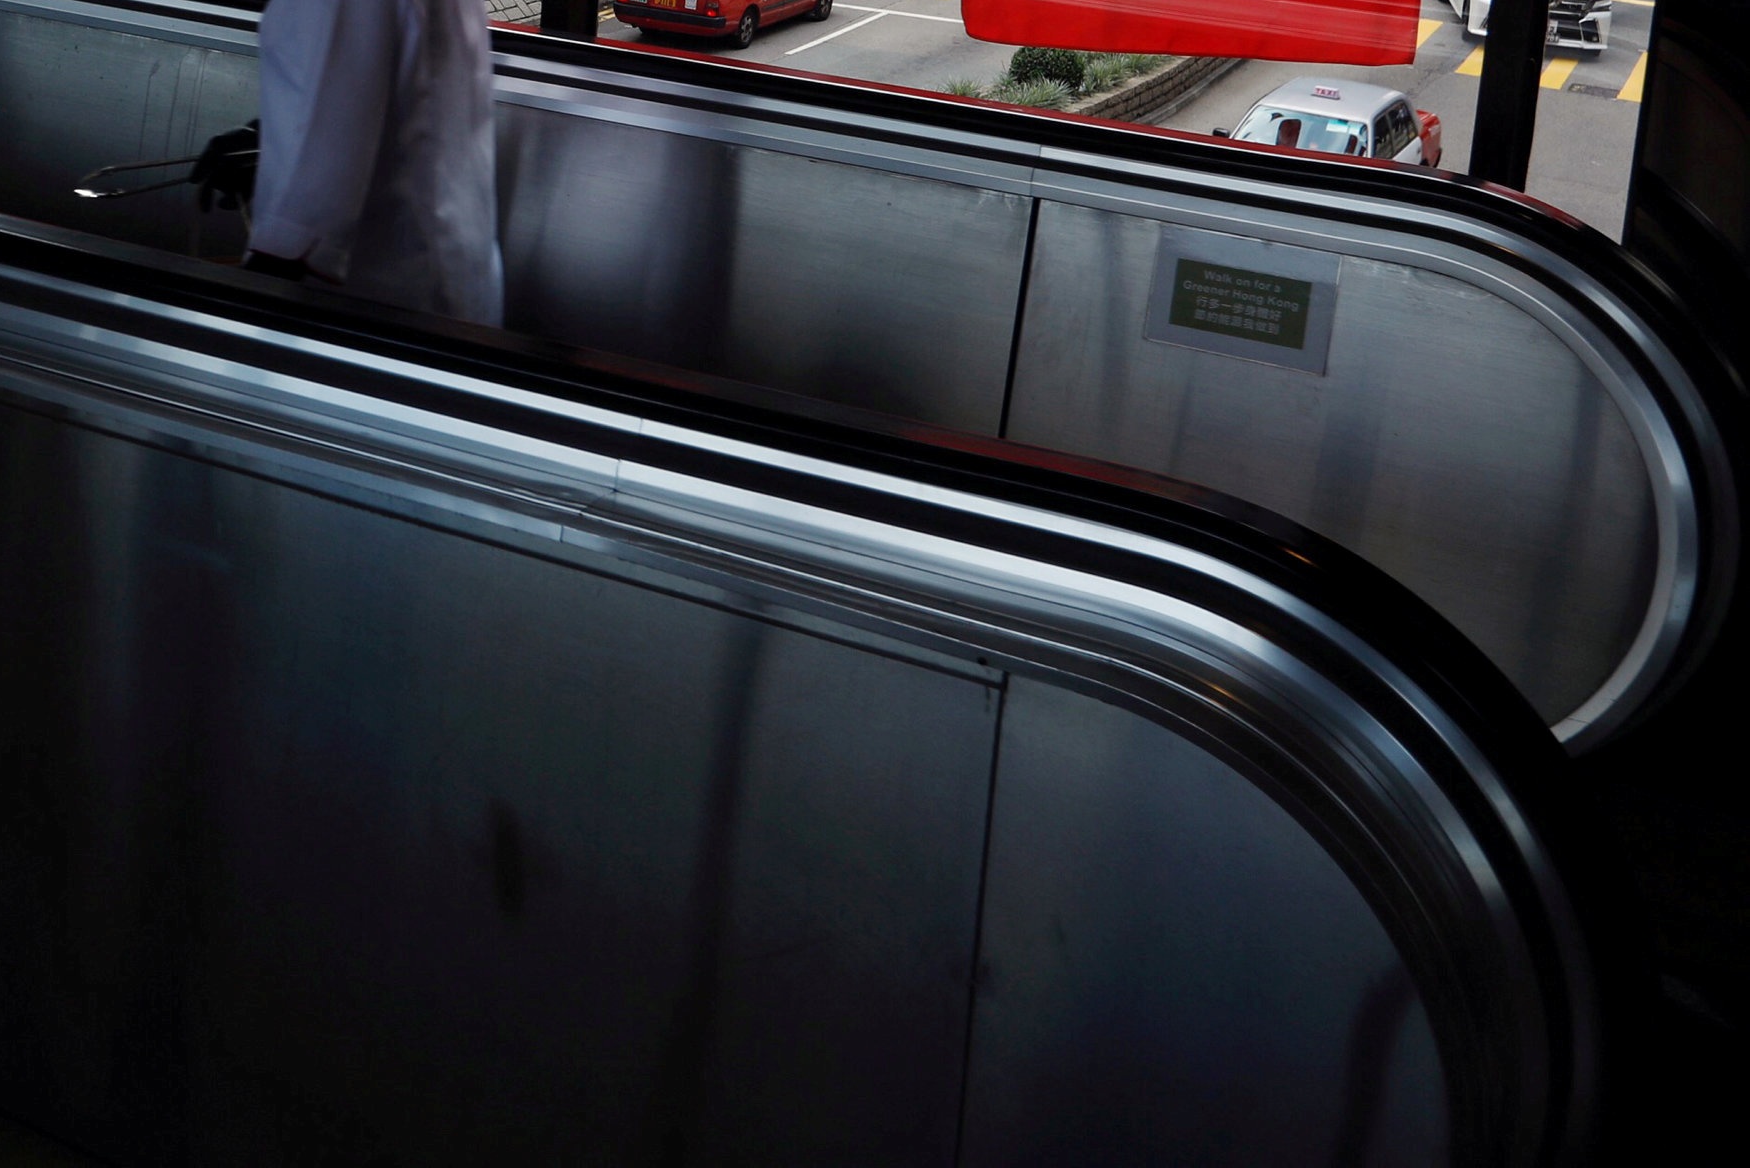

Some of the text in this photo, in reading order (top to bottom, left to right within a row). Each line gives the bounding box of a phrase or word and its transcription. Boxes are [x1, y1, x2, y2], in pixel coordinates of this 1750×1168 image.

[1182, 279, 1299, 312] Greener Hong Kong
[1203, 270, 1282, 293] Walk on for a
